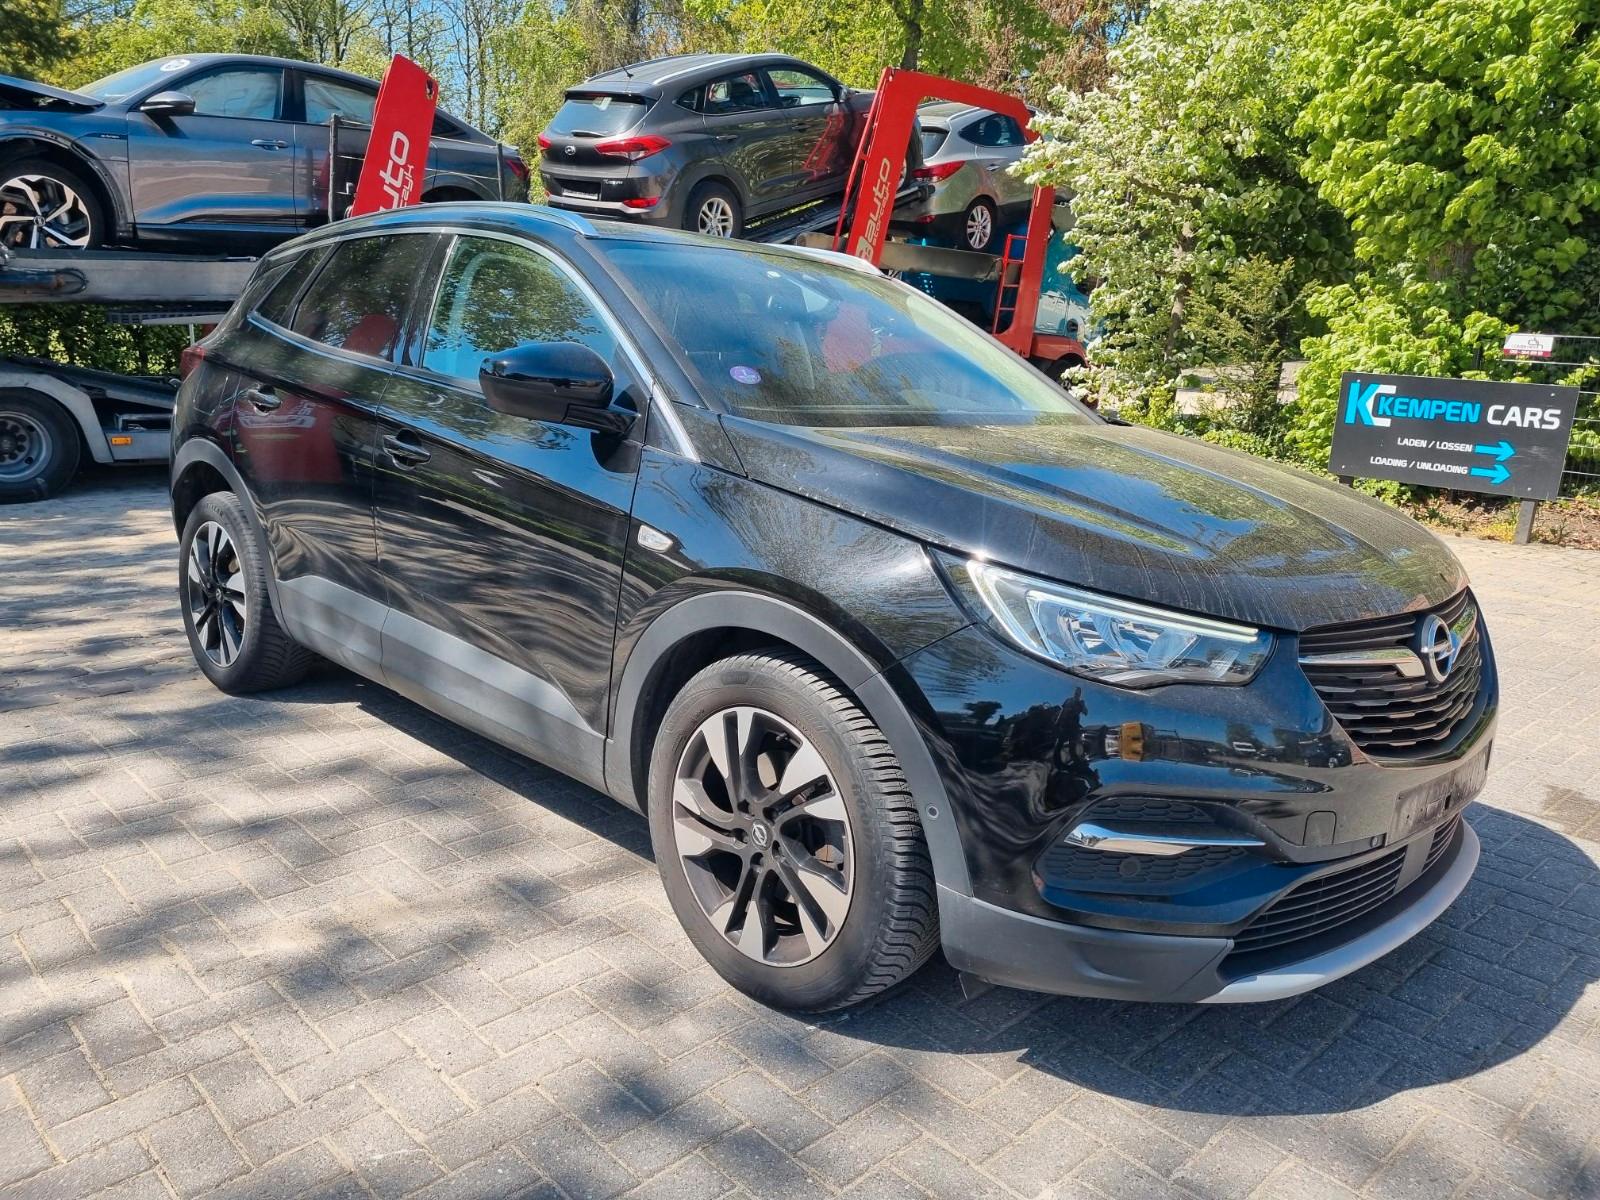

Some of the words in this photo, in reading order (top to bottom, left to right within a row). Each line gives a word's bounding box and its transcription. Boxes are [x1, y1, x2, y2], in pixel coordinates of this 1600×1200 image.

[379, 131, 410, 210] uto
[1378, 396, 1481, 423] KEMPEN
[1487, 405, 1561, 430] CARS
[1398, 437, 1428, 448] LADEN
[1436, 441, 1472, 452] LOSSEN
[1370, 456, 1407, 468] LOADING
[1416, 462, 1468, 475] UNLOADING
